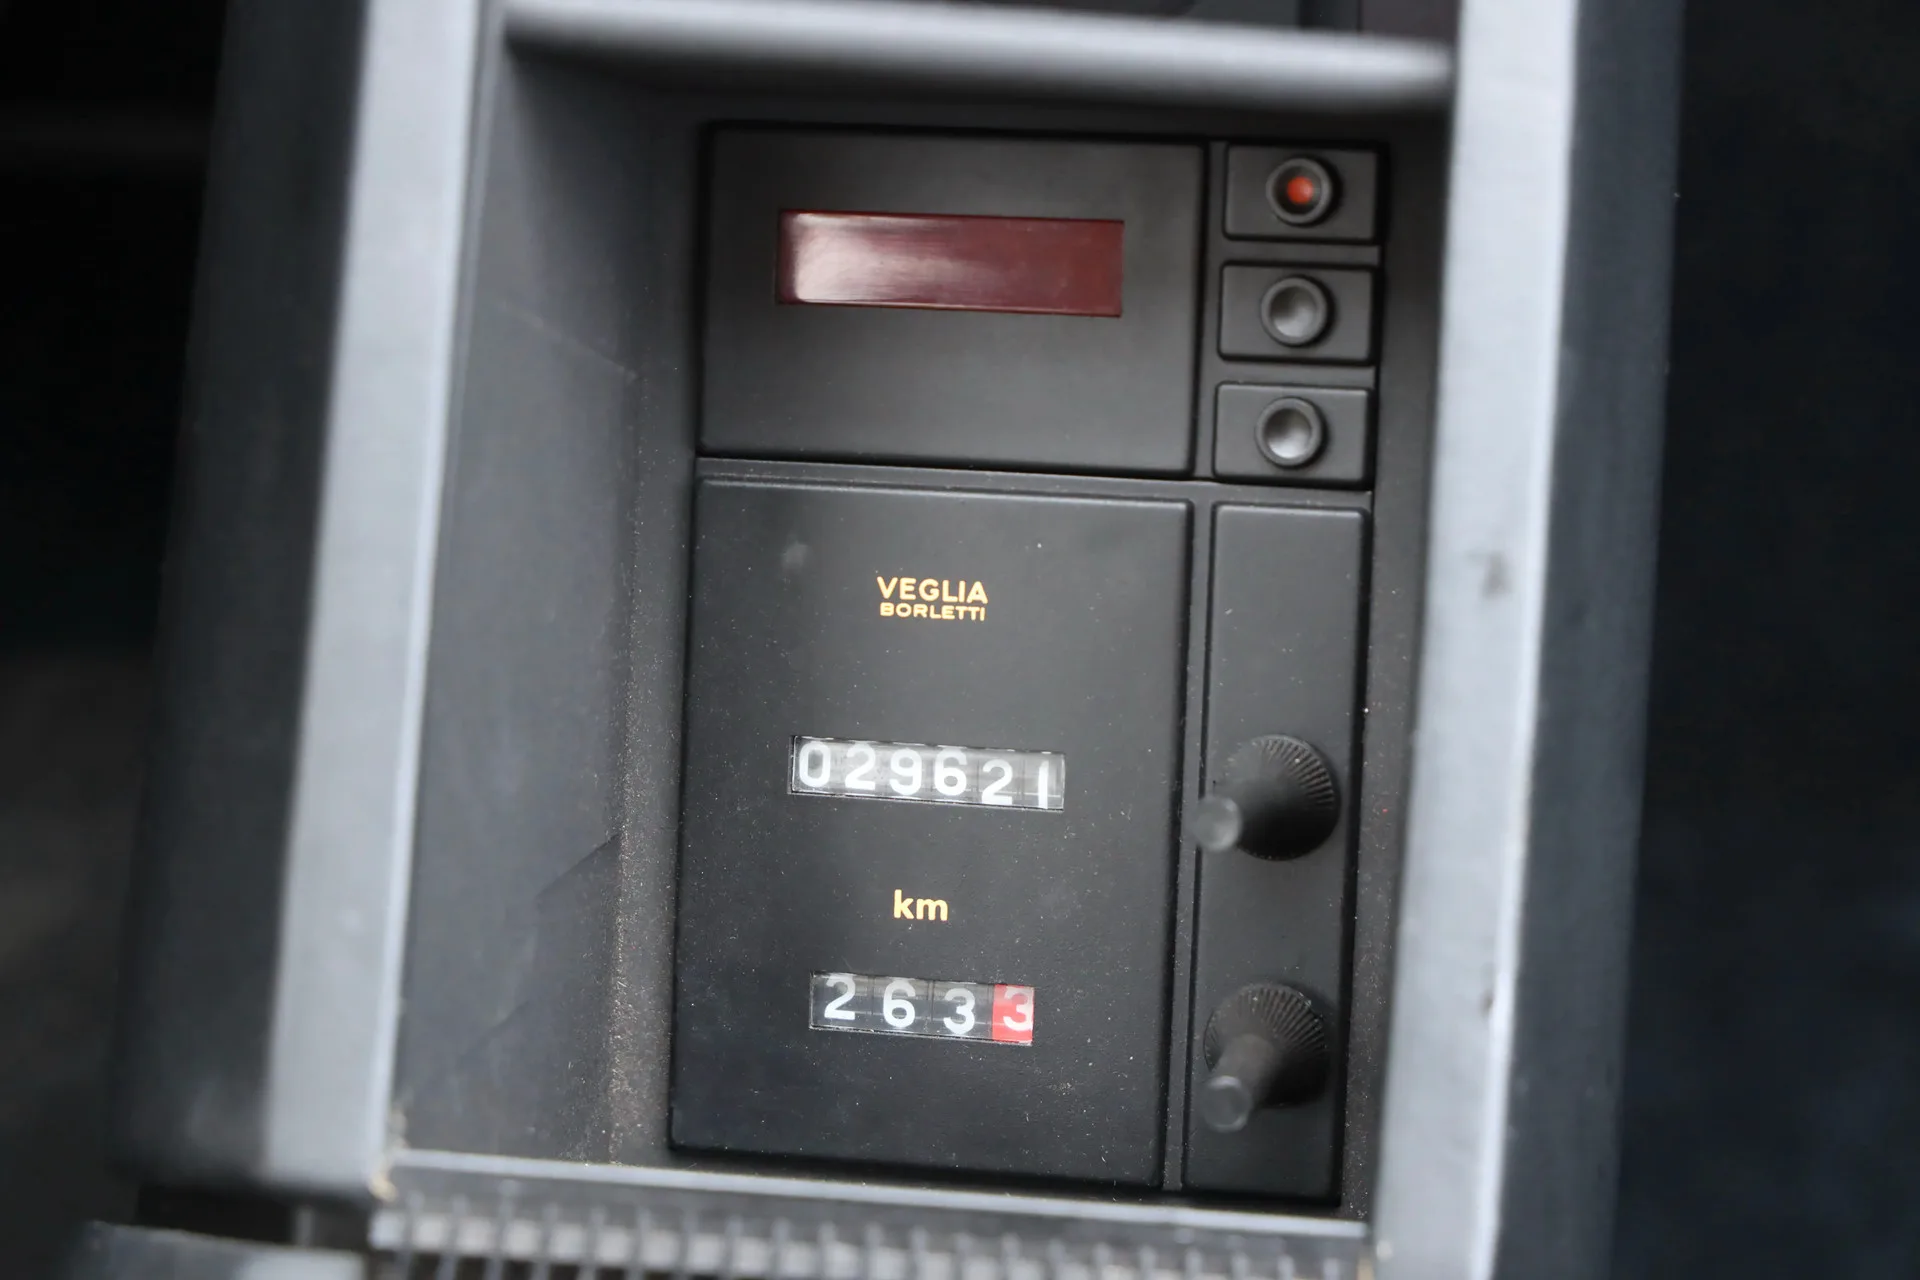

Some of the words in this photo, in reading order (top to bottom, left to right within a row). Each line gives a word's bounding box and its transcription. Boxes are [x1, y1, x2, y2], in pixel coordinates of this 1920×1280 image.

[876, 576, 989, 604] VEGLIA
[879, 602, 986, 621] BORLETTI
[799, 740, 1050, 809] 029621
[893, 889, 948, 921] km
